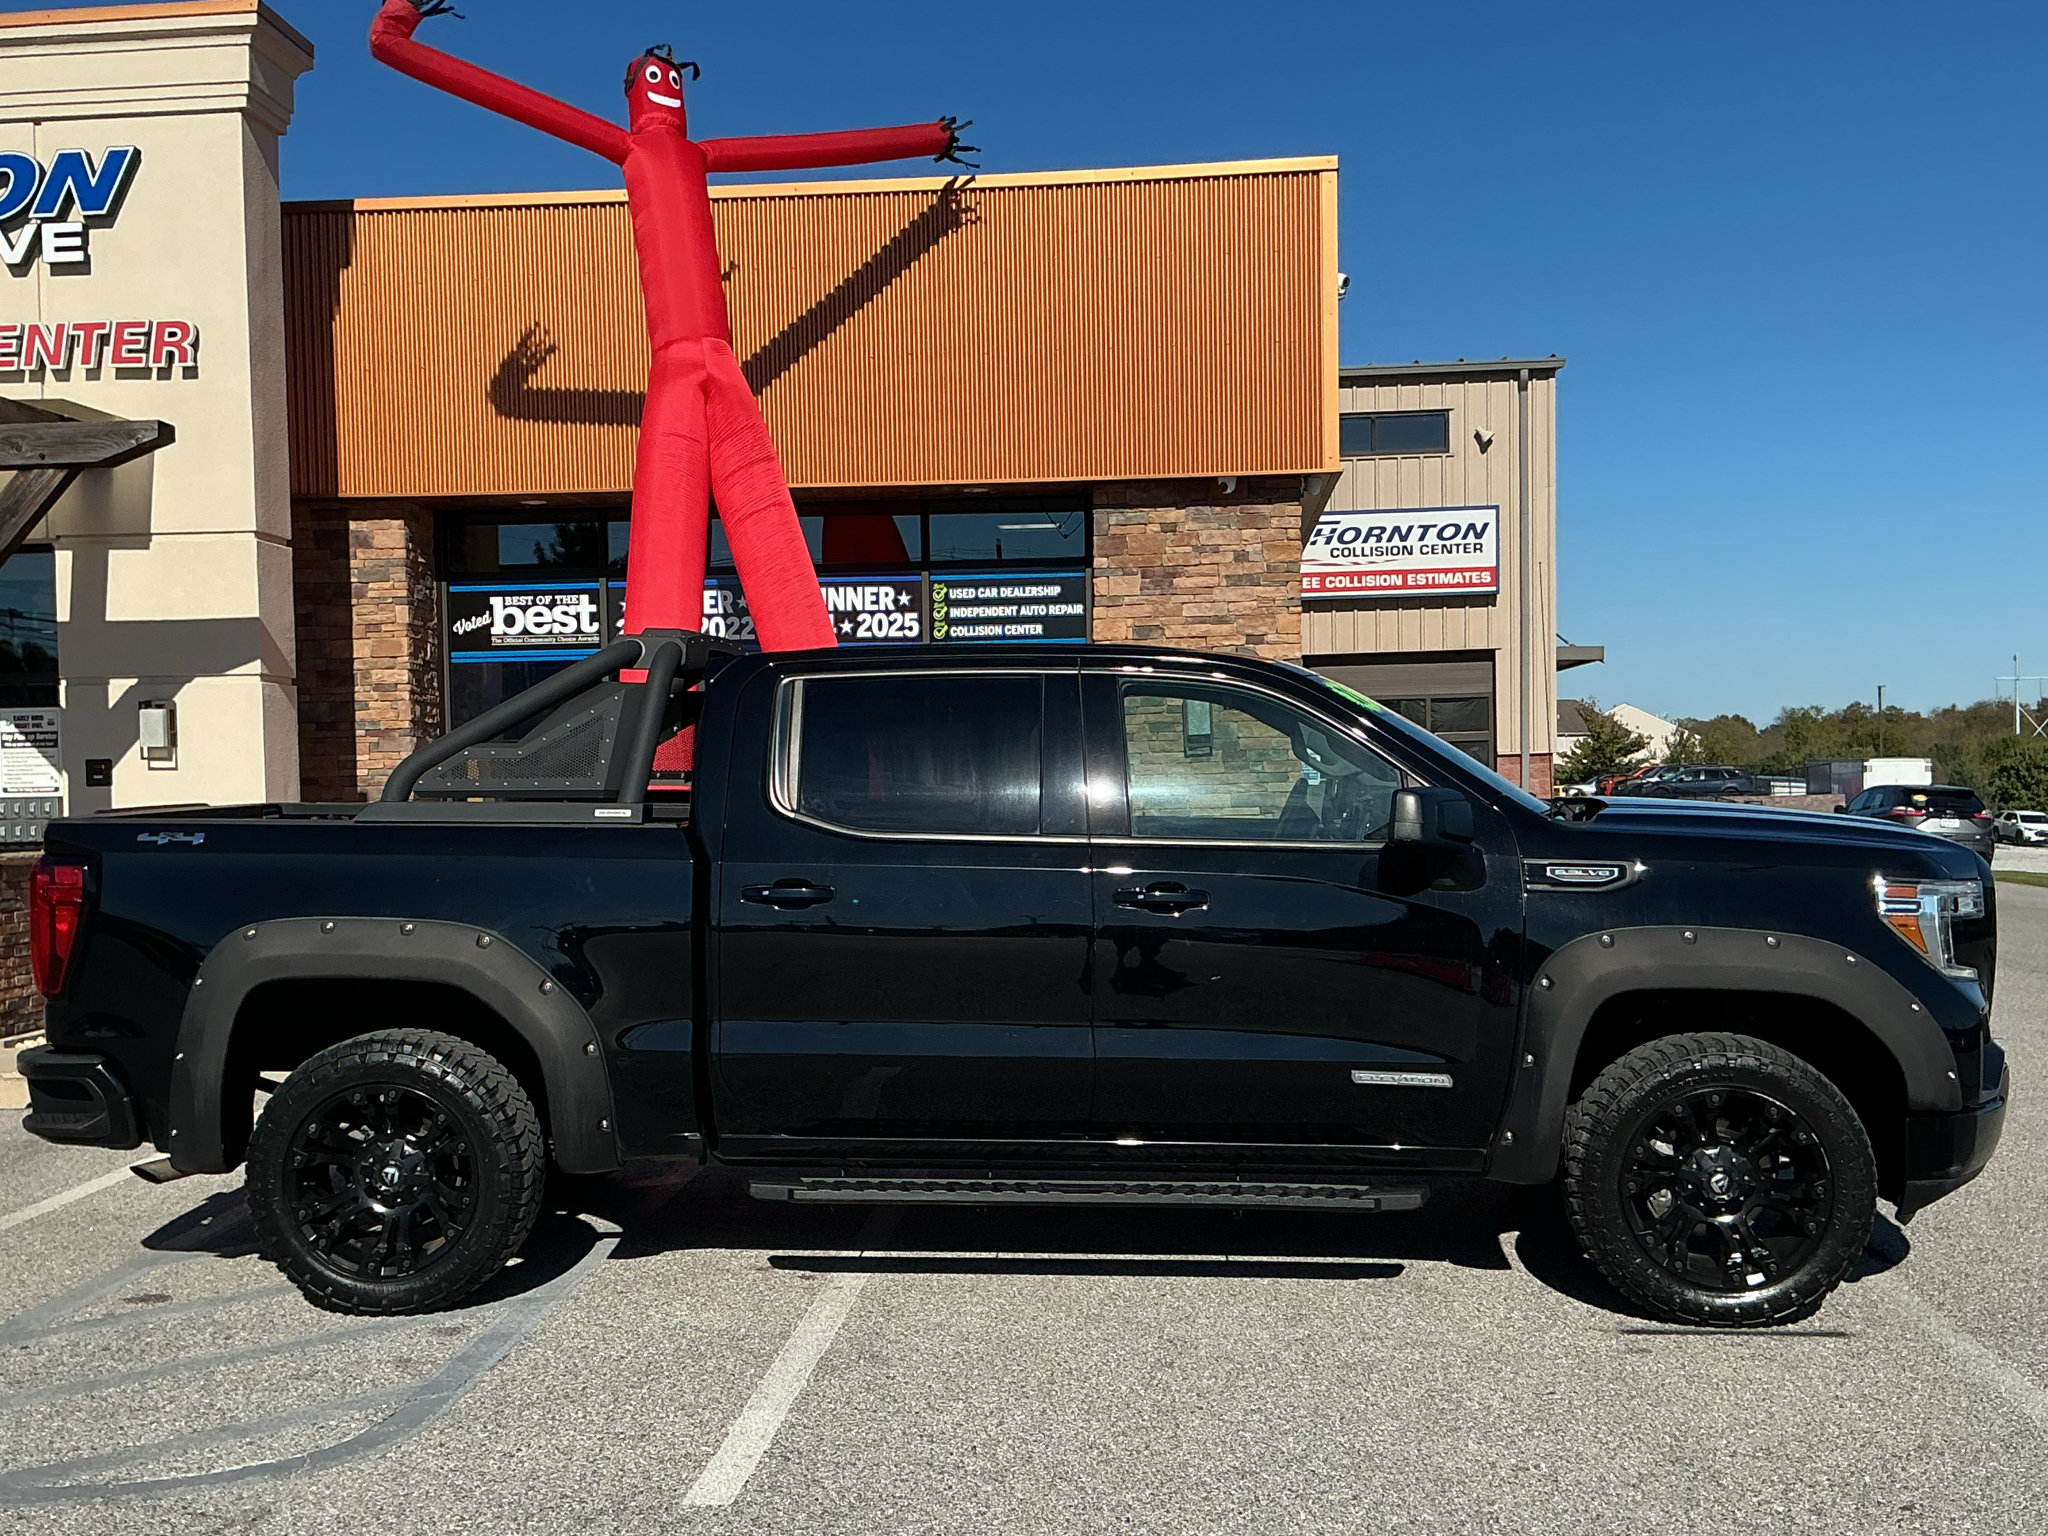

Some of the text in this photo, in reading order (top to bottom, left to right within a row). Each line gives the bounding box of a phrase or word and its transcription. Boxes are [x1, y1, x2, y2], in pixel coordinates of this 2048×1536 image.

[0, 320, 196, 371] ENTER
[1330, 542, 1483, 558] COLLISION CENTER
[1325, 573, 1402, 588] COLLISION
[1407, 571, 1491, 586] ESTIMATES
[505, 594, 579, 606] BEST OF THE
[949, 586, 1061, 599] USED CAR DEALERSHIP
[490, 594, 599, 635] best
[950, 604, 1083, 617] INDEPENDENT AUTO REPAIR
[453, 610, 492, 635] Voted
[856, 612, 920, 638] 2025
[950, 624, 1042, 637] COLLISION CENTER
[1356, 1074, 1445, 1084] ELEVATION
